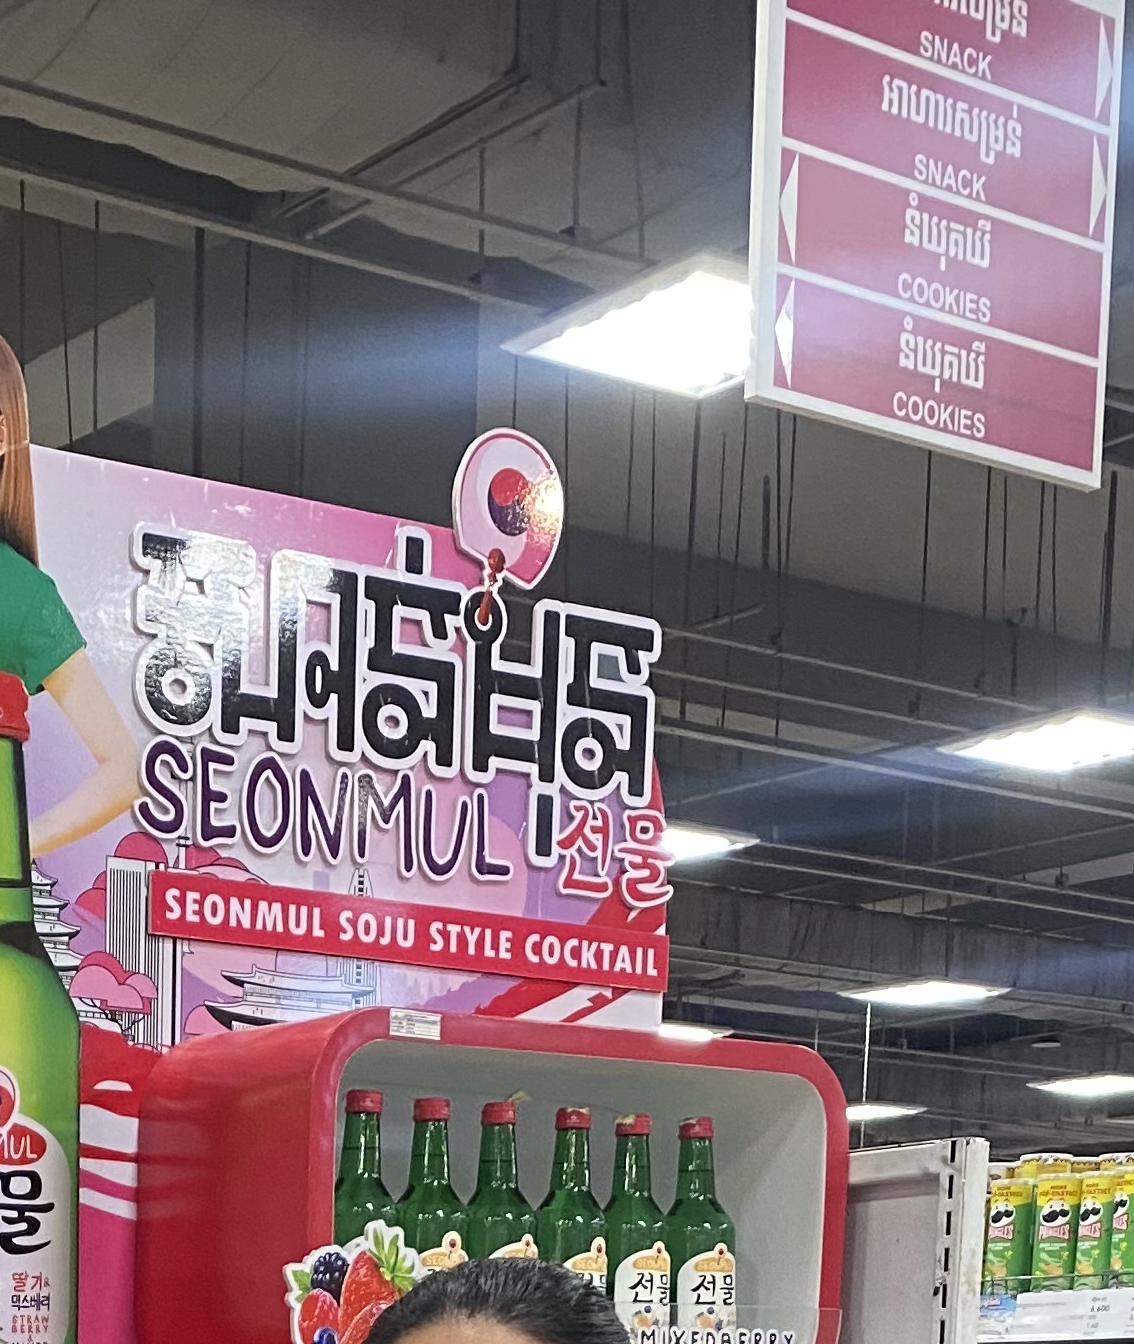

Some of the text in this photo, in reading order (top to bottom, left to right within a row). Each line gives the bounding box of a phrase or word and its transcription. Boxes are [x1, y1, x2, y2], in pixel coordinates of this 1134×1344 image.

[919, 30, 992, 81] SNACK
[914, 153, 987, 201] SNACK
[897, 272, 991, 324] COOKIES
[892, 391, 986, 438] COOKIES
[138, 738, 512, 879] SEONMUL
[164, 886, 659, 978] SEONMUL SOJU STYLE COCKTAIL
[11, 1324, 49, 1335] BERRY
